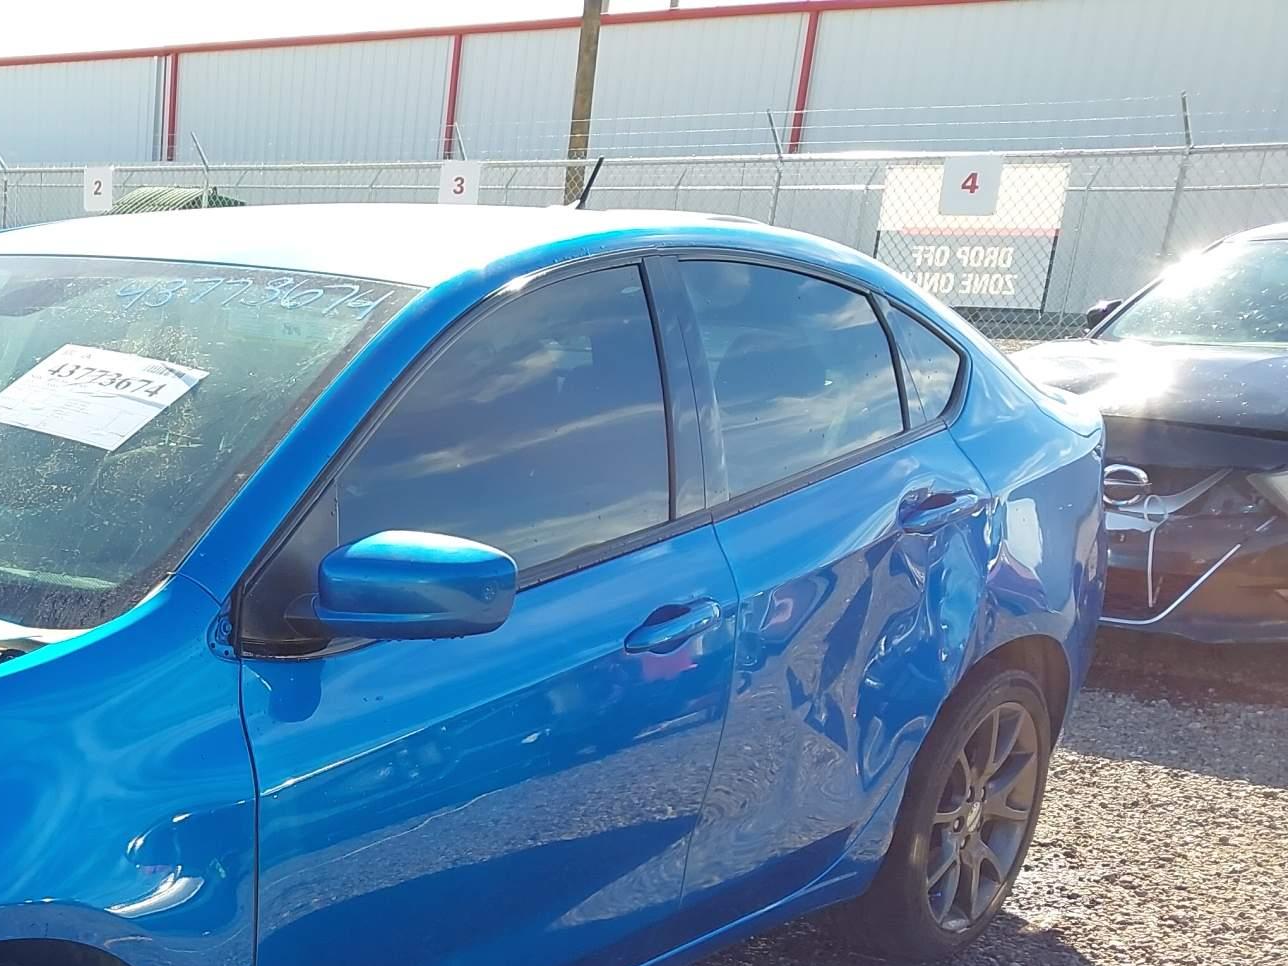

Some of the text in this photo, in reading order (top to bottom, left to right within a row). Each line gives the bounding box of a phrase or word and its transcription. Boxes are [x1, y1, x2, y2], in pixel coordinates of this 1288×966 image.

[93, 180, 102, 196] 2
[453, 176, 465, 195] 3
[961, 172, 979, 194] 4
[47, 362, 167, 398] 43773674
